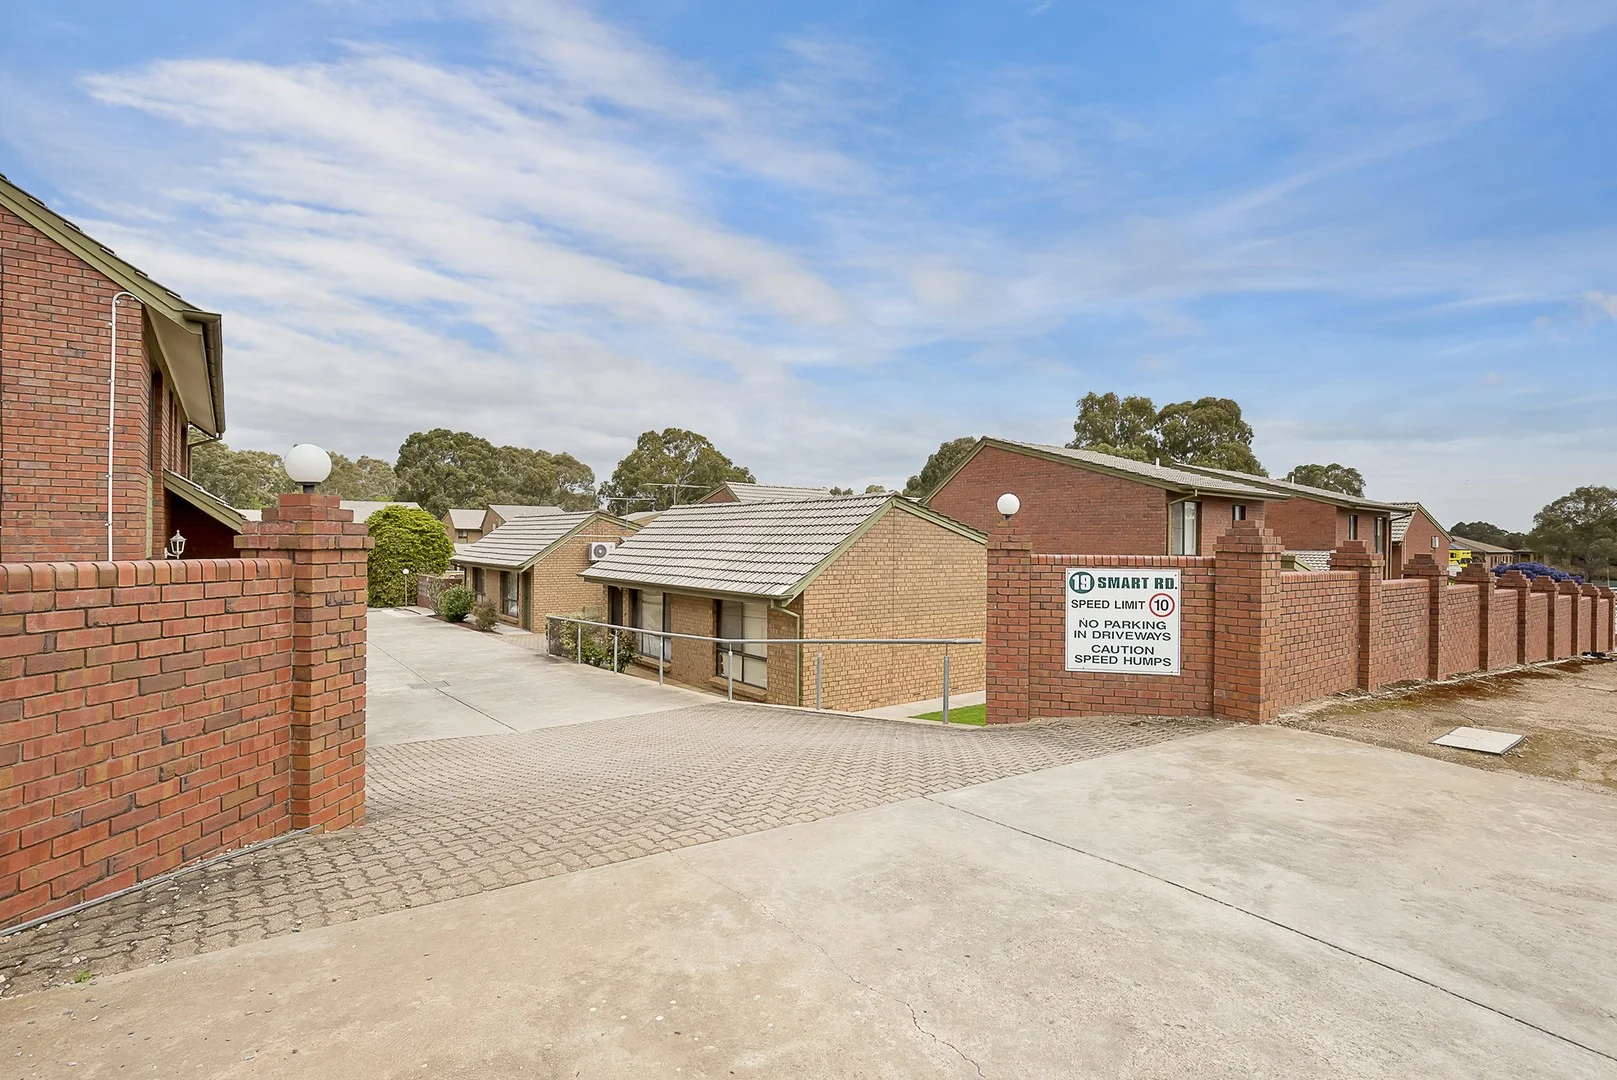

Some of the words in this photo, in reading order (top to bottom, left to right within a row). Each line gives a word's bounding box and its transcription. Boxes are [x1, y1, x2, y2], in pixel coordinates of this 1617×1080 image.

[1072, 574, 1091, 590] 19
[1098, 577, 1149, 589] SMART
[1071, 599, 1110, 609] SPEED
[1115, 601, 1145, 609] LIMIT
[1155, 599, 1169, 611] 10
[1079, 620, 1098, 628] NO
[1105, 620, 1166, 630] PARKING
[1074, 630, 1086, 638] IN
[1093, 631, 1171, 641] DRIVEWAYS
[1091, 645, 1154, 655] CAUTION
[1075, 655, 1118, 664] SPEED
[1124, 657, 1171, 667] HUMPS
